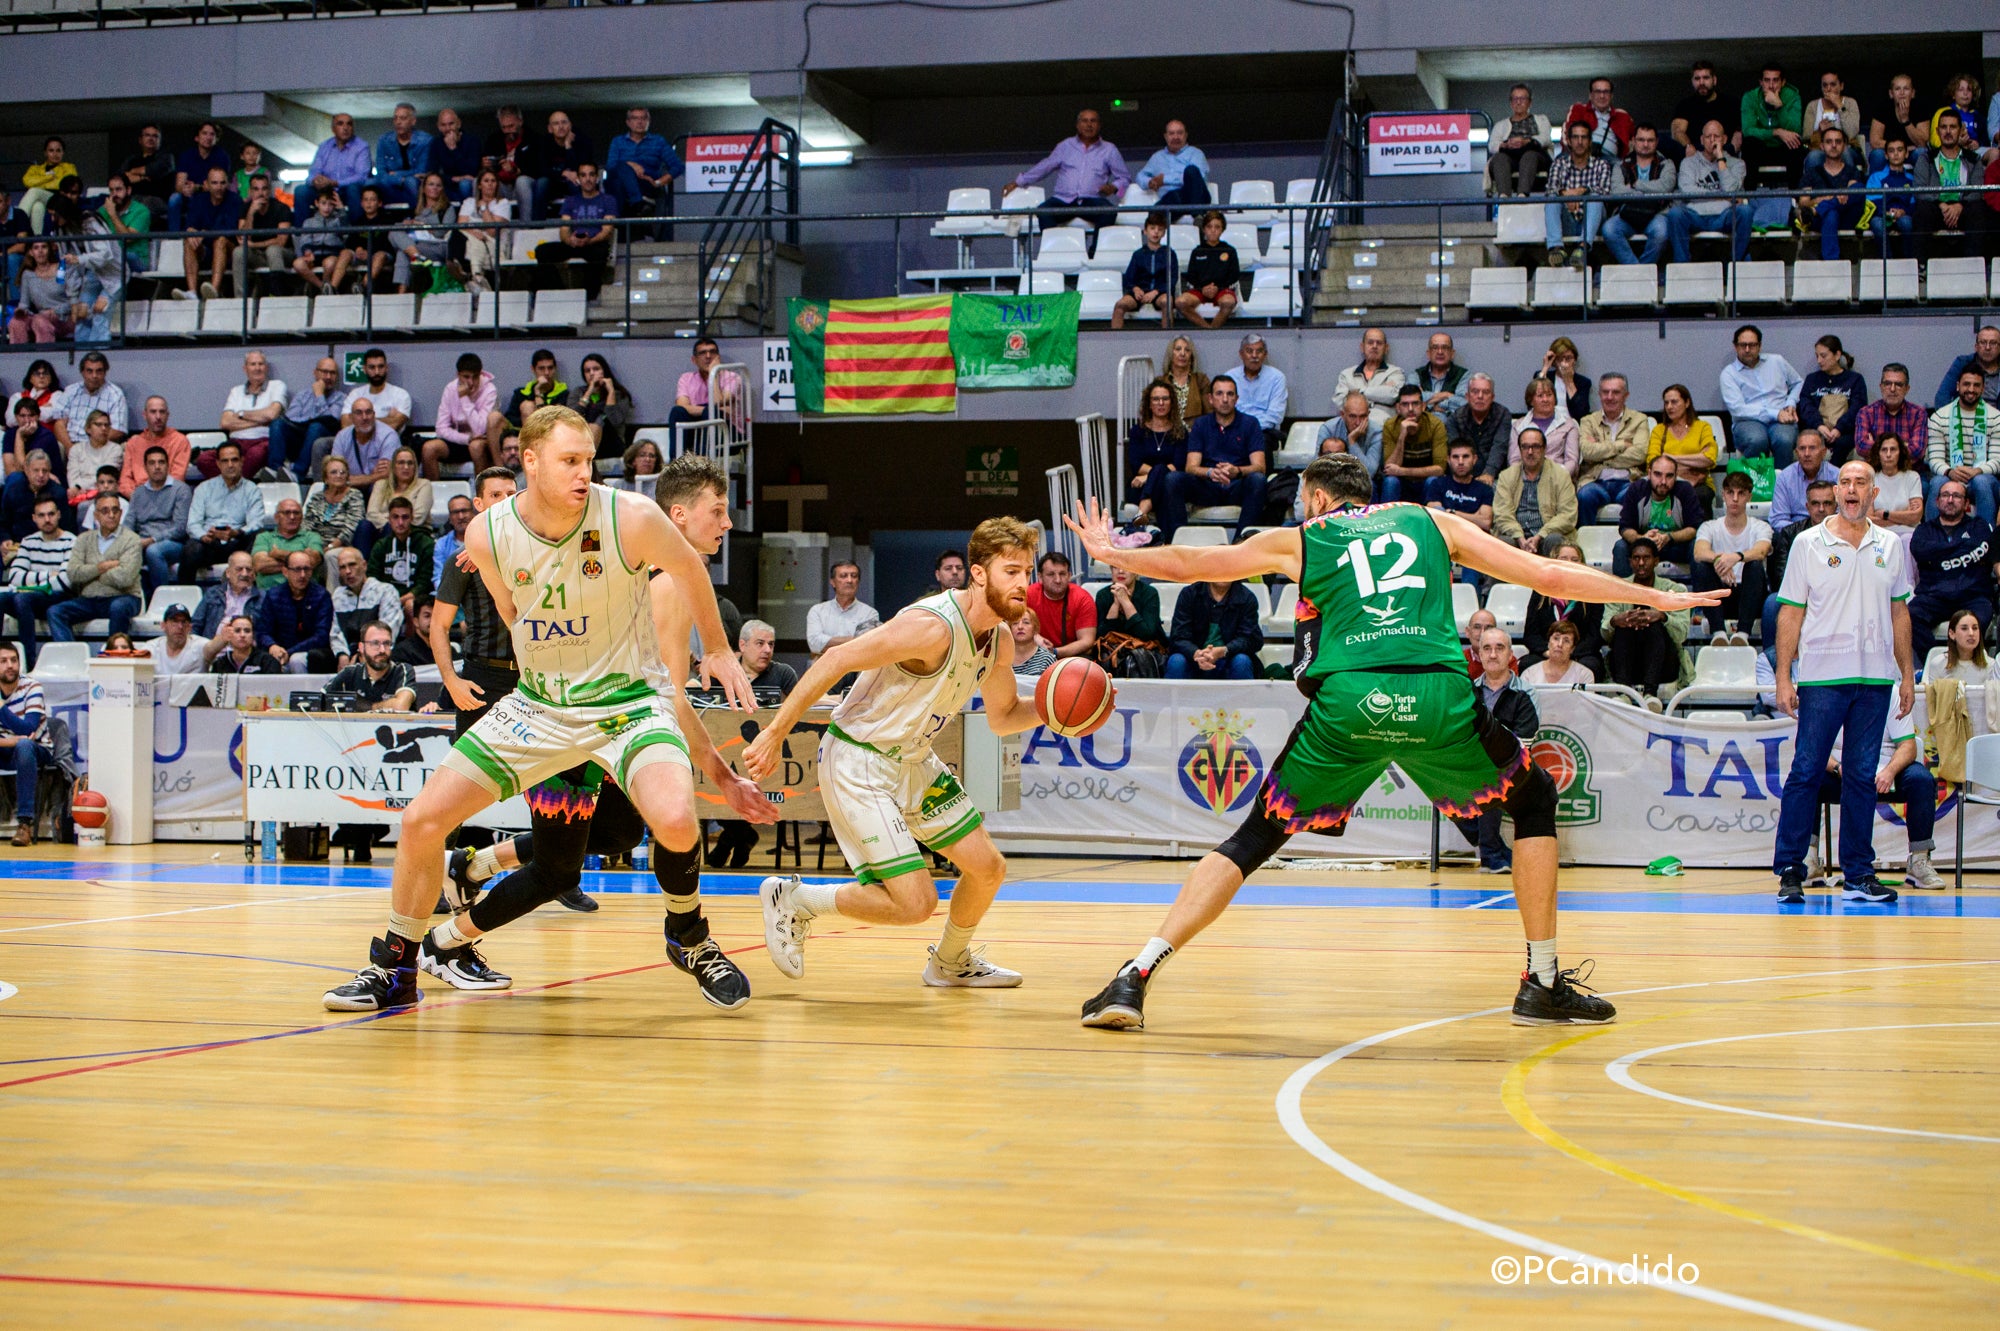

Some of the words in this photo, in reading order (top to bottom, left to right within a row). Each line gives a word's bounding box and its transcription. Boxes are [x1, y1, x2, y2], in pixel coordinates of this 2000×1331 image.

[1380, 124, 1445, 137] LATERAL
[1448, 122, 1460, 134] A
[1381, 145, 1421, 157] IMPAR
[1424, 144, 1460, 155] BAJO
[702, 164, 727, 175] PAR
[997, 303, 1044, 323] TAU
[1336, 532, 1427, 599] 12
[541, 582, 567, 610] 21
[523, 616, 590, 642] TAU
[1345, 624, 1427, 646] Extremadura
[1393, 694, 1417, 703] Torta
[1397, 703, 1412, 713] del
[1391, 712, 1419, 722] Casar
[248, 764, 409, 793] PATRONAT
